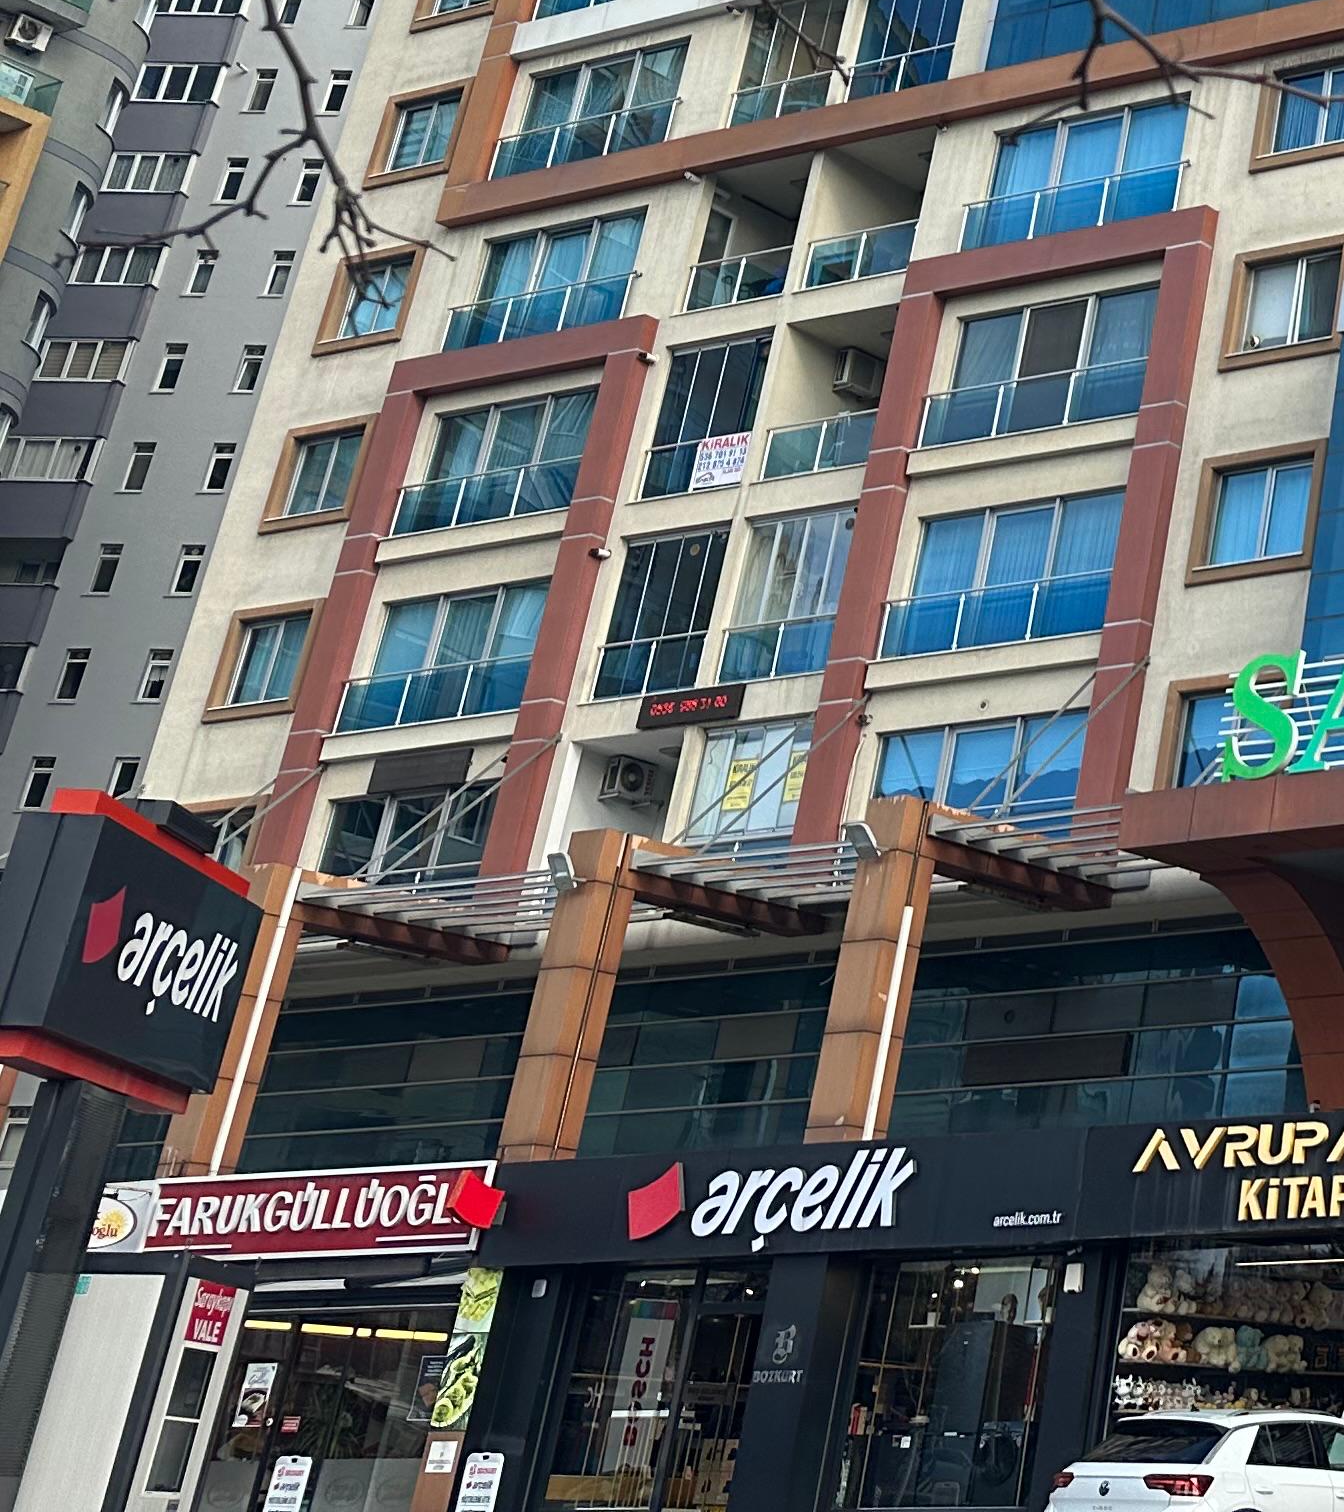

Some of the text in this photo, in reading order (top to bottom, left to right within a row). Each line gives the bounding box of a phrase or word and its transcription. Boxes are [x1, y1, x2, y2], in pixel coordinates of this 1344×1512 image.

[117, 912, 238, 1022] arçelik
[148, 1175, 462, 1238] FARUKGÜLLÜOĞL
[690, 1147, 916, 1253] arçelik
[193, 1319, 222, 1343] VALE
[623, 1336, 656, 1447] BOSCH
[752, 1369, 804, 1384] BOZKURT
